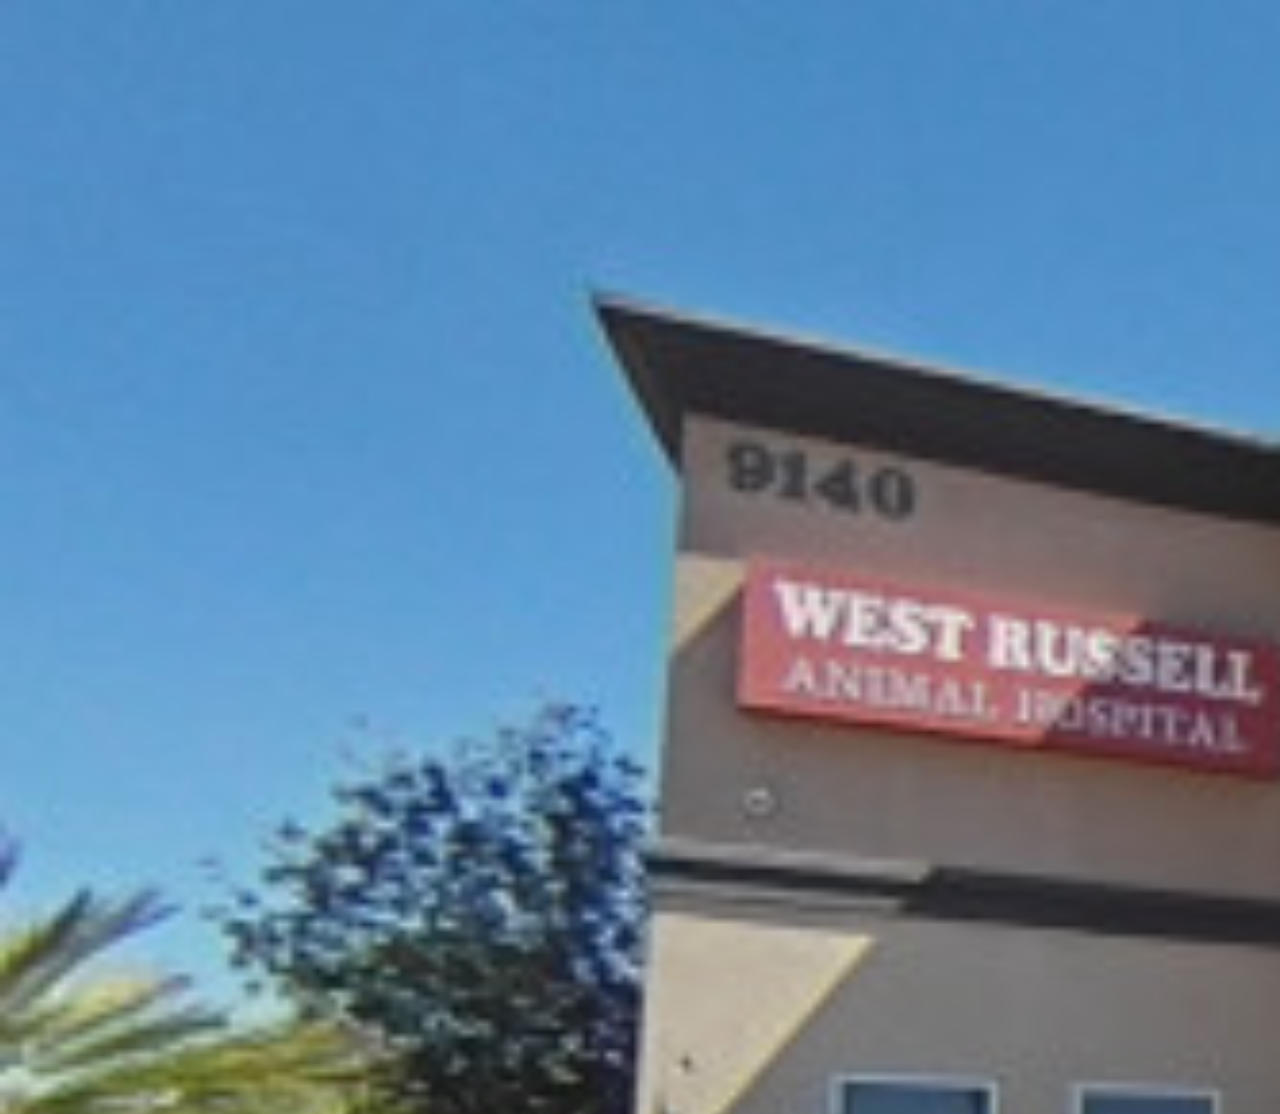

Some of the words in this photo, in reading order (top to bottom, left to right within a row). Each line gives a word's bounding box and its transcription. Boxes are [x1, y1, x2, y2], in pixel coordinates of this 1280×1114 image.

[729, 444, 915, 519] 9140
[775, 582, 974, 661] WEST
[989, 617, 1260, 700] RUSSELL
[786, 661, 993, 718] ANIMAL
[1018, 689, 1244, 751] HOSPITAL
